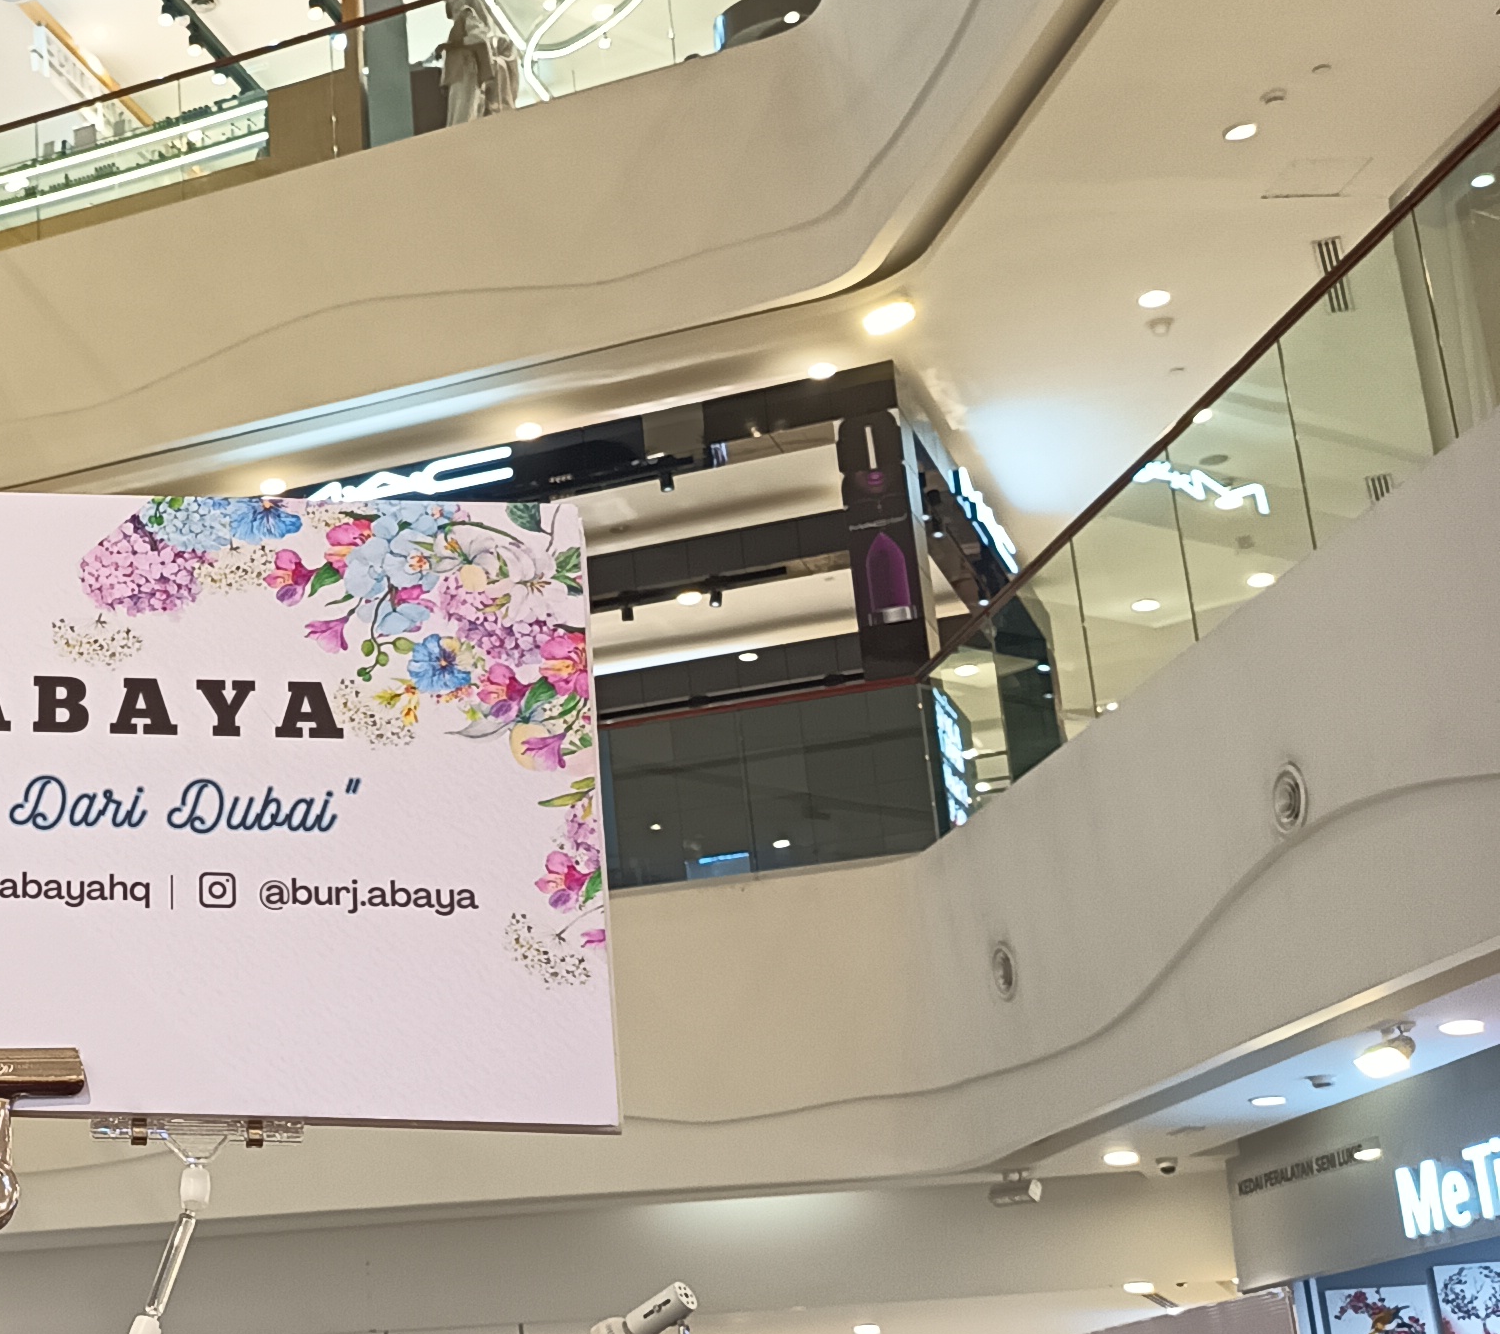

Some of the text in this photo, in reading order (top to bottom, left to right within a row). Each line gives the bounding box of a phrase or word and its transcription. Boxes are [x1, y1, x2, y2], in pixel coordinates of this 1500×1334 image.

[8, 774, 148, 832] Dari
[166, 776, 363, 834] Dubai"
[258, 876, 480, 916] @burj.abaya
[1237, 1174, 1264, 1197] KEDAI
[1263, 1157, 1315, 1189] PERALATAN
[1315, 1152, 1337, 1174] SENI
